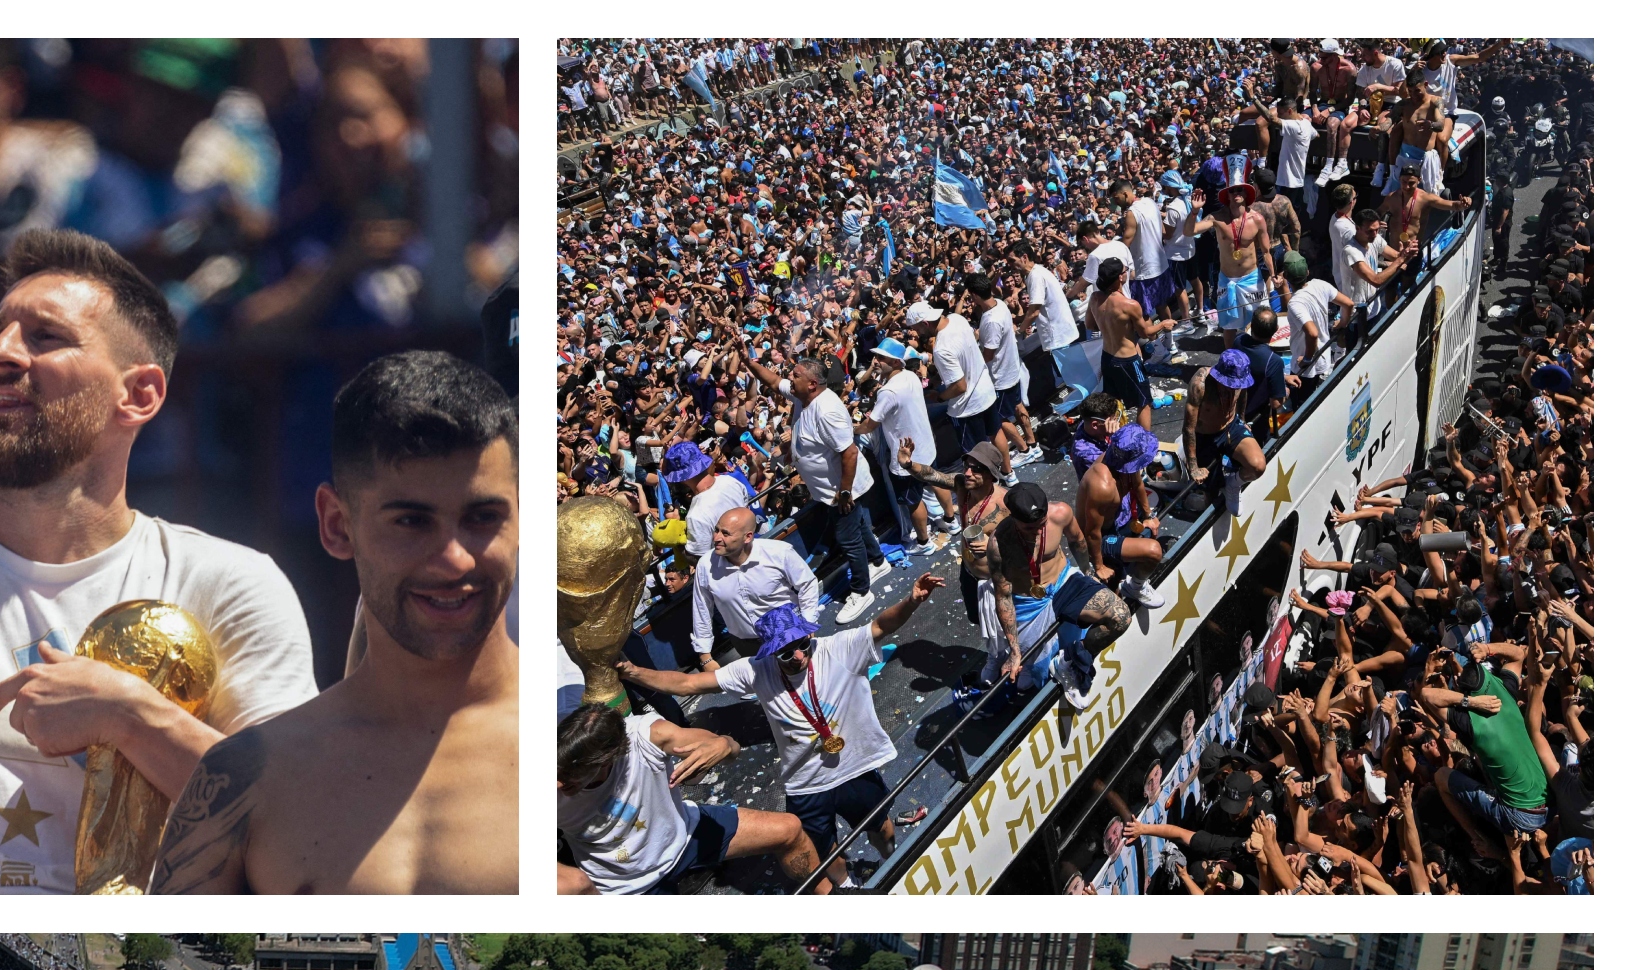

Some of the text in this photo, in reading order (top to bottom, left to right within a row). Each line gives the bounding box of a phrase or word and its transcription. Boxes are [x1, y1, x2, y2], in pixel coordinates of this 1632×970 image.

[1229, 156, 1244, 167] 23
[1352, 419, 1392, 487] YPF
[1005, 686, 1126, 855] MUNDO
